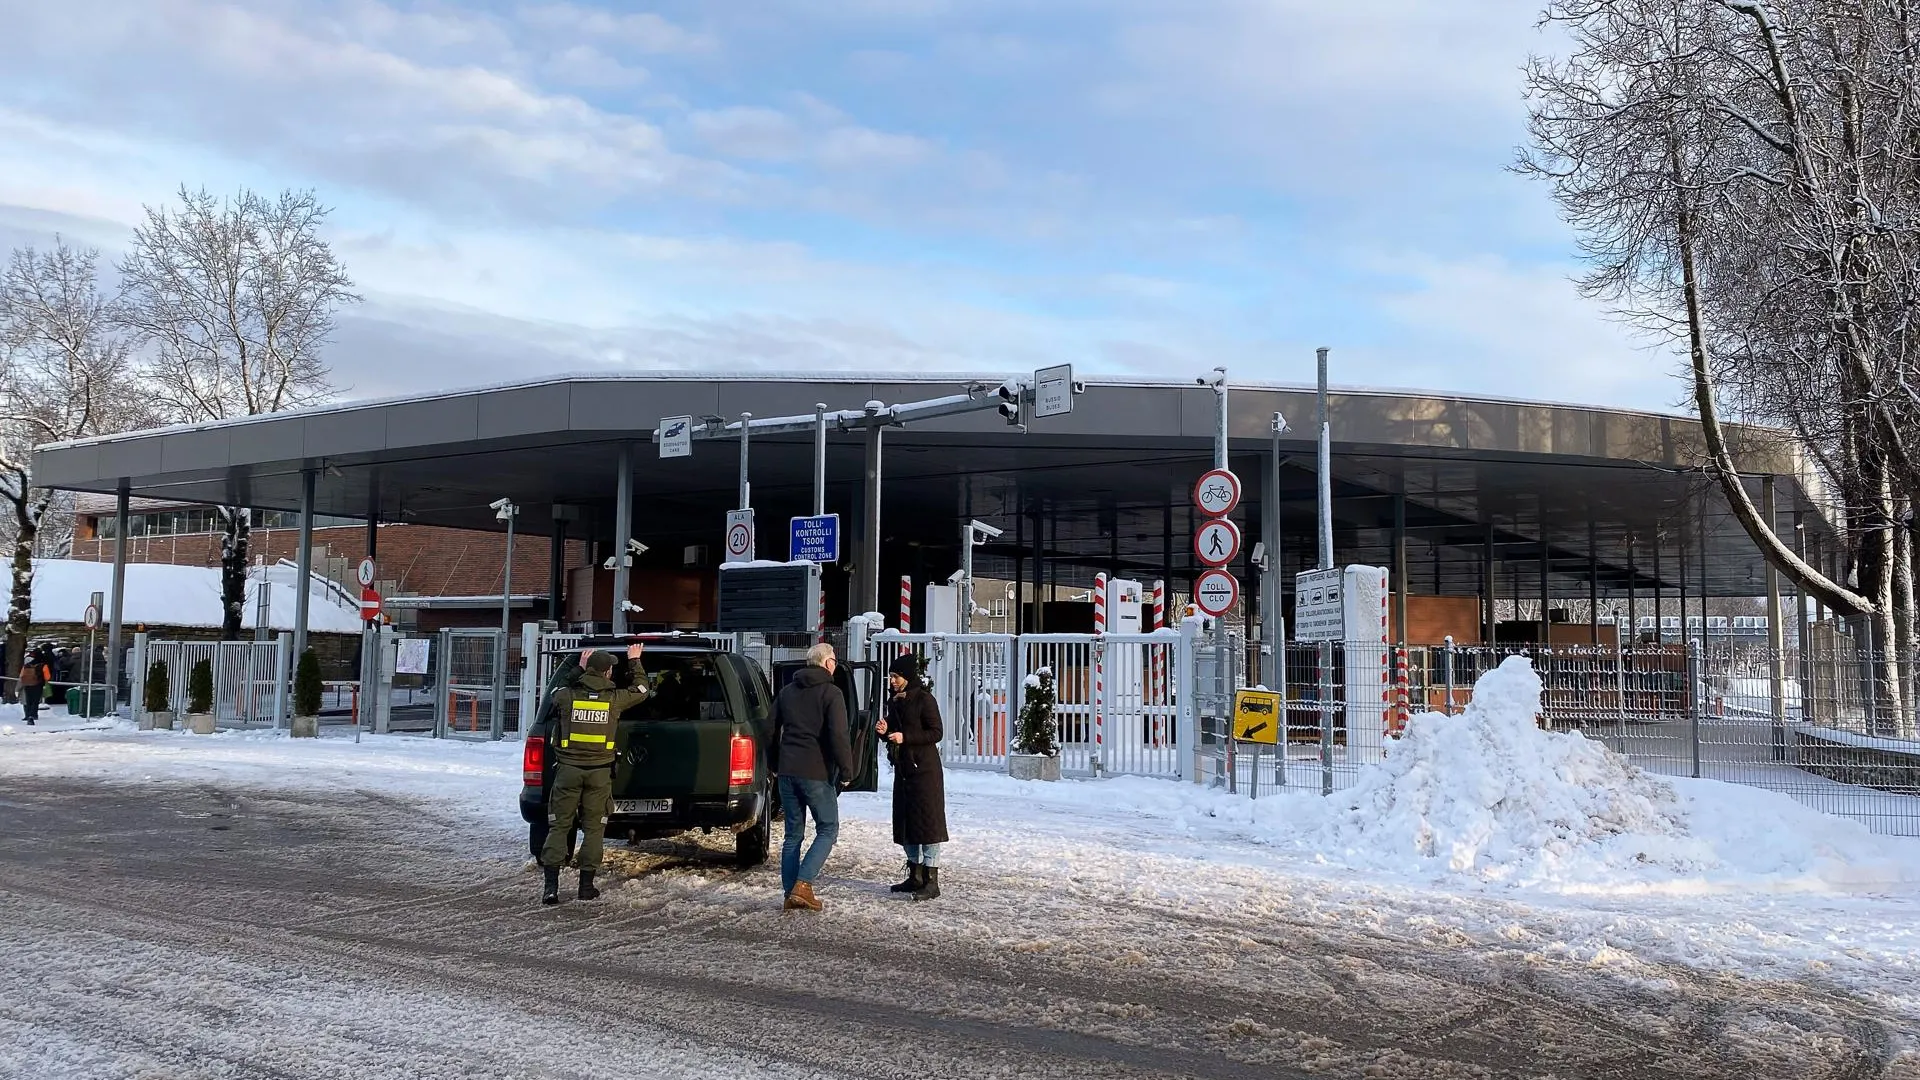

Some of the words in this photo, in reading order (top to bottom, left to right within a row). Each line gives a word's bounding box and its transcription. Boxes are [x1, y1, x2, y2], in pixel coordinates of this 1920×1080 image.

[733, 513, 745, 521] ALA
[795, 528, 832, 538] KONTROLLI
[733, 532, 746, 547] 20
[802, 536, 825, 546] TSOON
[800, 546, 825, 554] CUSTOMS
[794, 553, 818, 561] CONTROL
[818, 552, 833, 560] ZONE
[1205, 583, 1225, 591] TOLL
[1209, 594, 1225, 602] CLO
[573, 709, 608, 722] POLITSEI
[615, 800, 637, 812] 723
[644, 800, 669, 812] TMB
